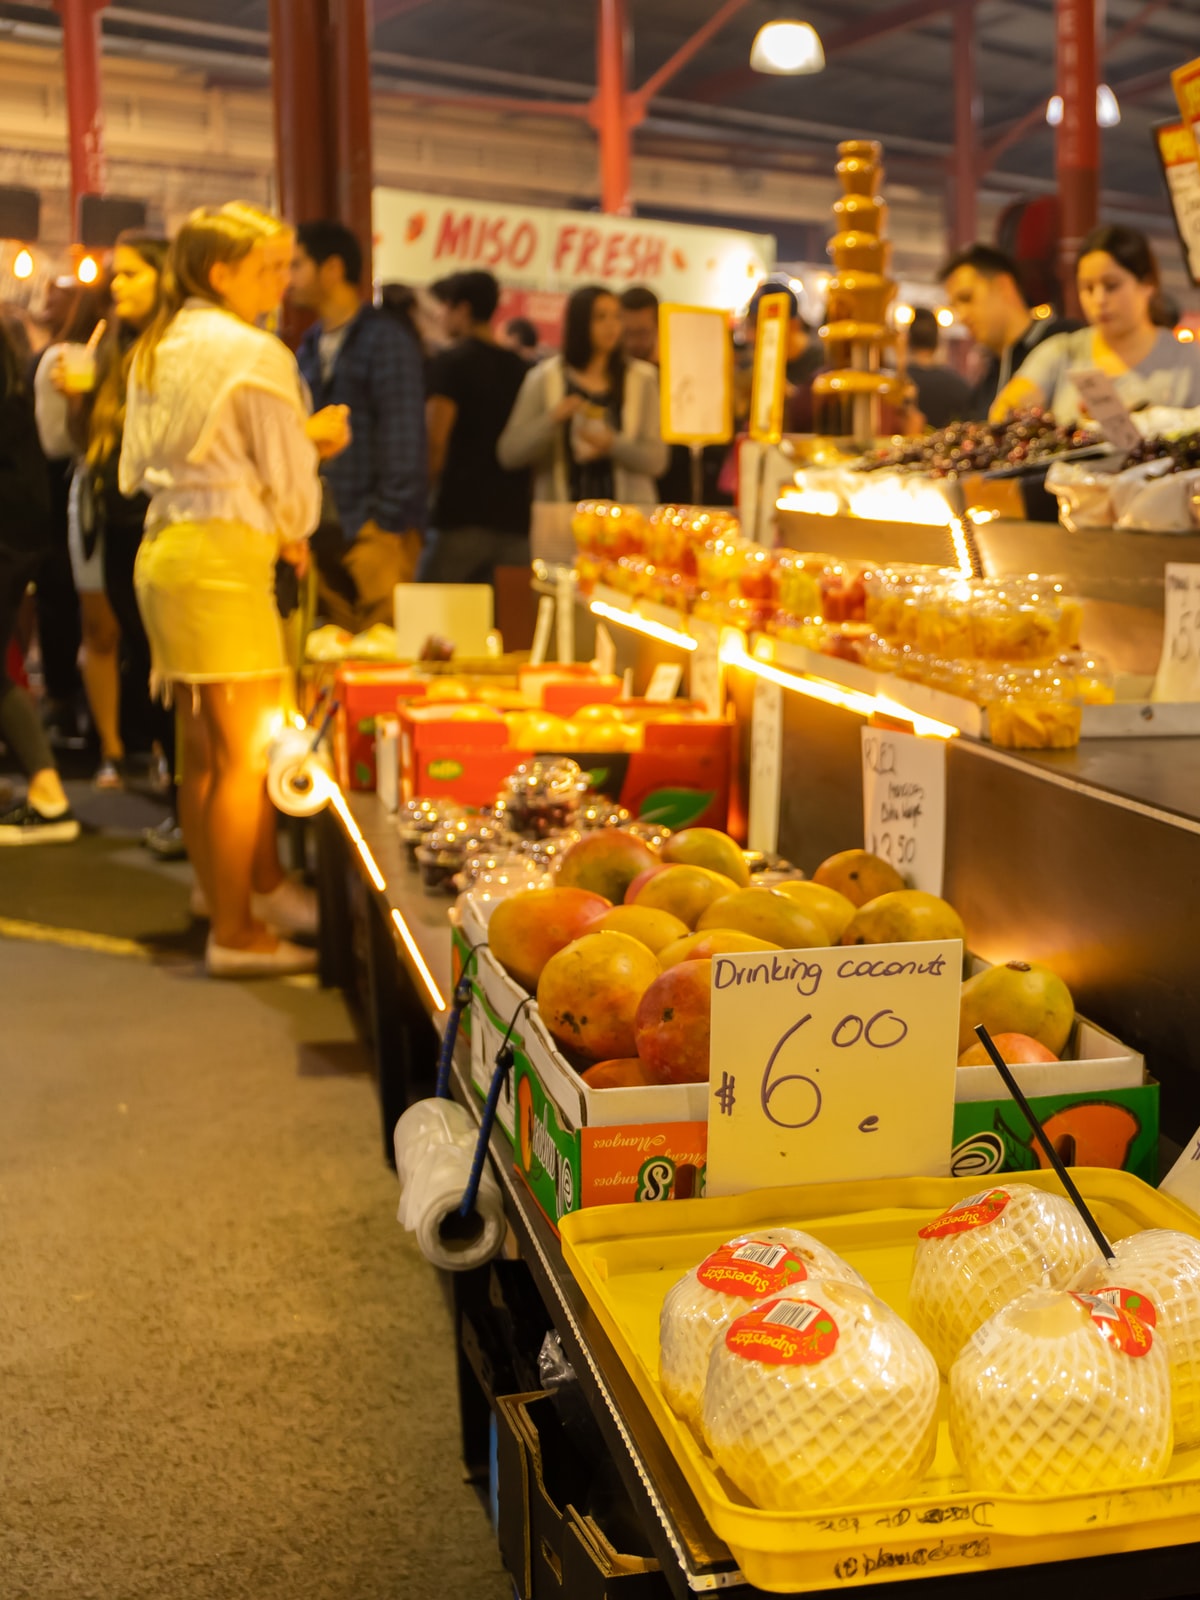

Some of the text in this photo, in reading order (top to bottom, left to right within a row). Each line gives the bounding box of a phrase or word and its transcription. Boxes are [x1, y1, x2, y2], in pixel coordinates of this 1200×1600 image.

[434, 211, 667, 278] MISO FRESH
[714, 954, 947, 996] Drinking coconuts
[593, 1133, 667, 1152] Mangoes
[593, 1175, 638, 1187] angoes
